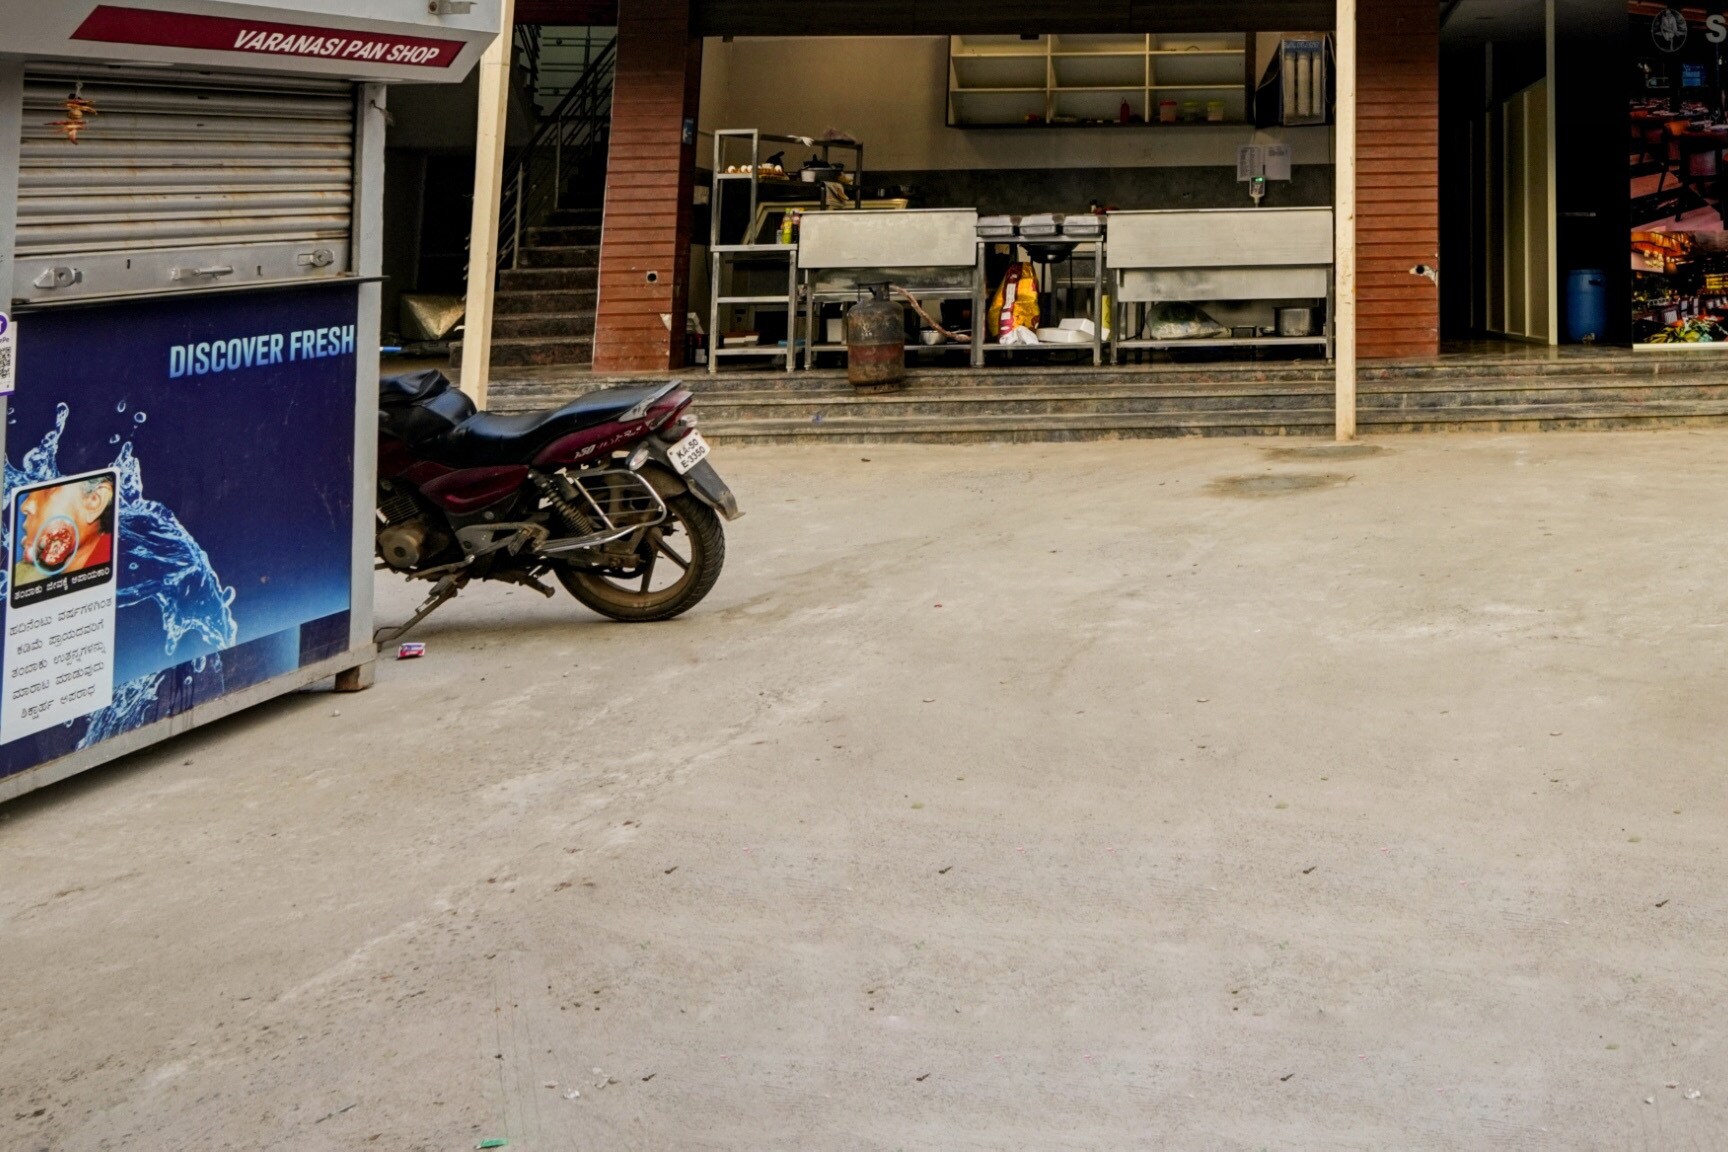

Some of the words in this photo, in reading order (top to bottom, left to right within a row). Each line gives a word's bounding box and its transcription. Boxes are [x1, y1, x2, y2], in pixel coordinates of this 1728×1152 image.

[233, 29, 346, 57] VARANASI
[342, 40, 390, 61] PAN
[386, 44, 440, 64] SHOP
[169, 333, 284, 379] DISCOVER
[290, 325, 355, 362] FRESH
[676, 438, 699, 459] KA-50
[681, 446, 706, 468] E-3350
